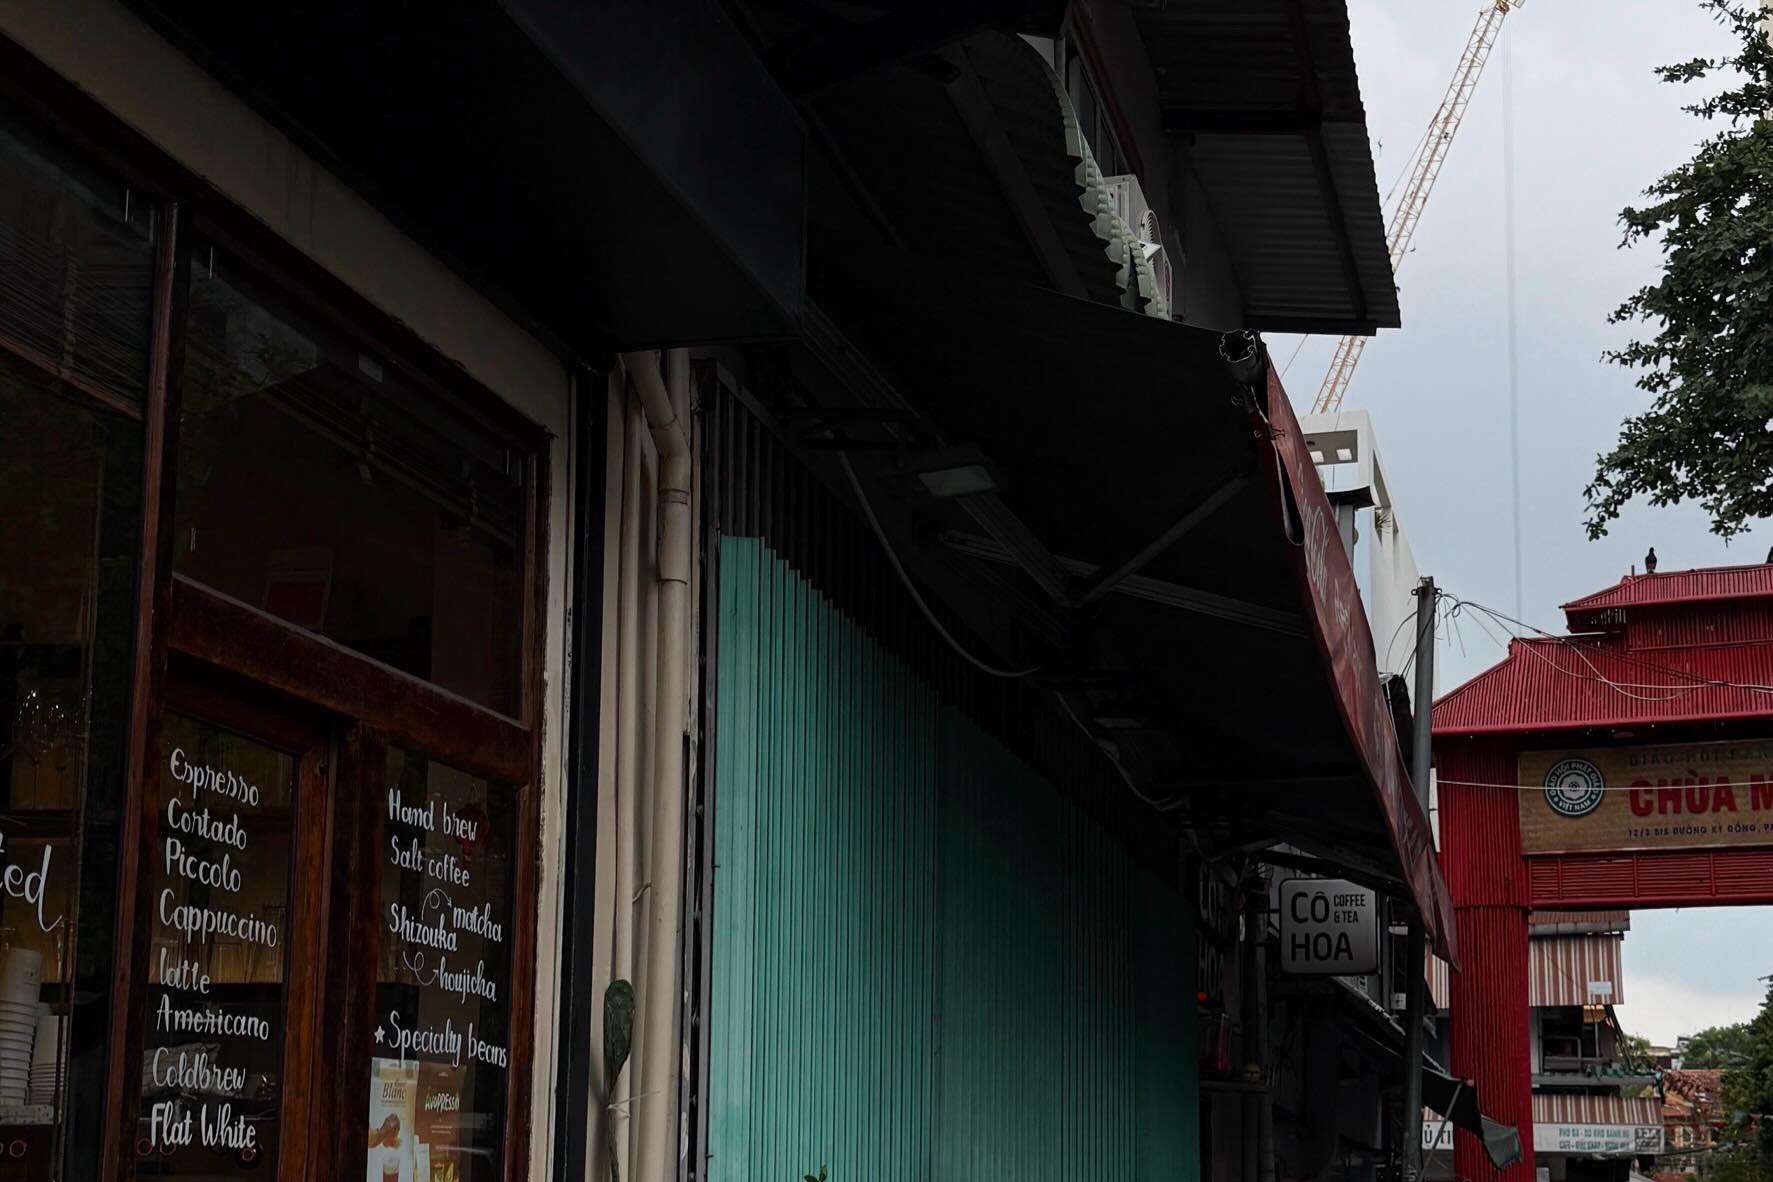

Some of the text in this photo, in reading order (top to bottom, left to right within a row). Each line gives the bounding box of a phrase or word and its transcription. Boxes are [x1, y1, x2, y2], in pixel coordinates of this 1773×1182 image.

[170, 747, 259, 807] Espresso
[1630, 769, 1737, 817] CHÙA
[168, 797, 247, 850] Cortado
[388, 787, 478, 842] Hand brew
[0, 832, 63, 932] ed
[166, 837, 241, 892] Piccolo
[391, 835, 470, 887] Salt coffee
[160, 888, 277, 948] Cappuccino
[389, 902, 458, 952] Shizouka
[453, 902, 503, 943] matcha
[1291, 891, 1366, 923] CÔ COFFEE
[1343, 911, 1359, 923] TEA
[1291, 932, 1354, 961] HOA
[438, 956, 497, 1004] houjicha
[156, 993, 270, 1040] Americano
[389, 1010, 507, 1070] Specialty beans
[152, 1047, 247, 1091] Coldbrew
[150, 1101, 256, 1149] Flat White
